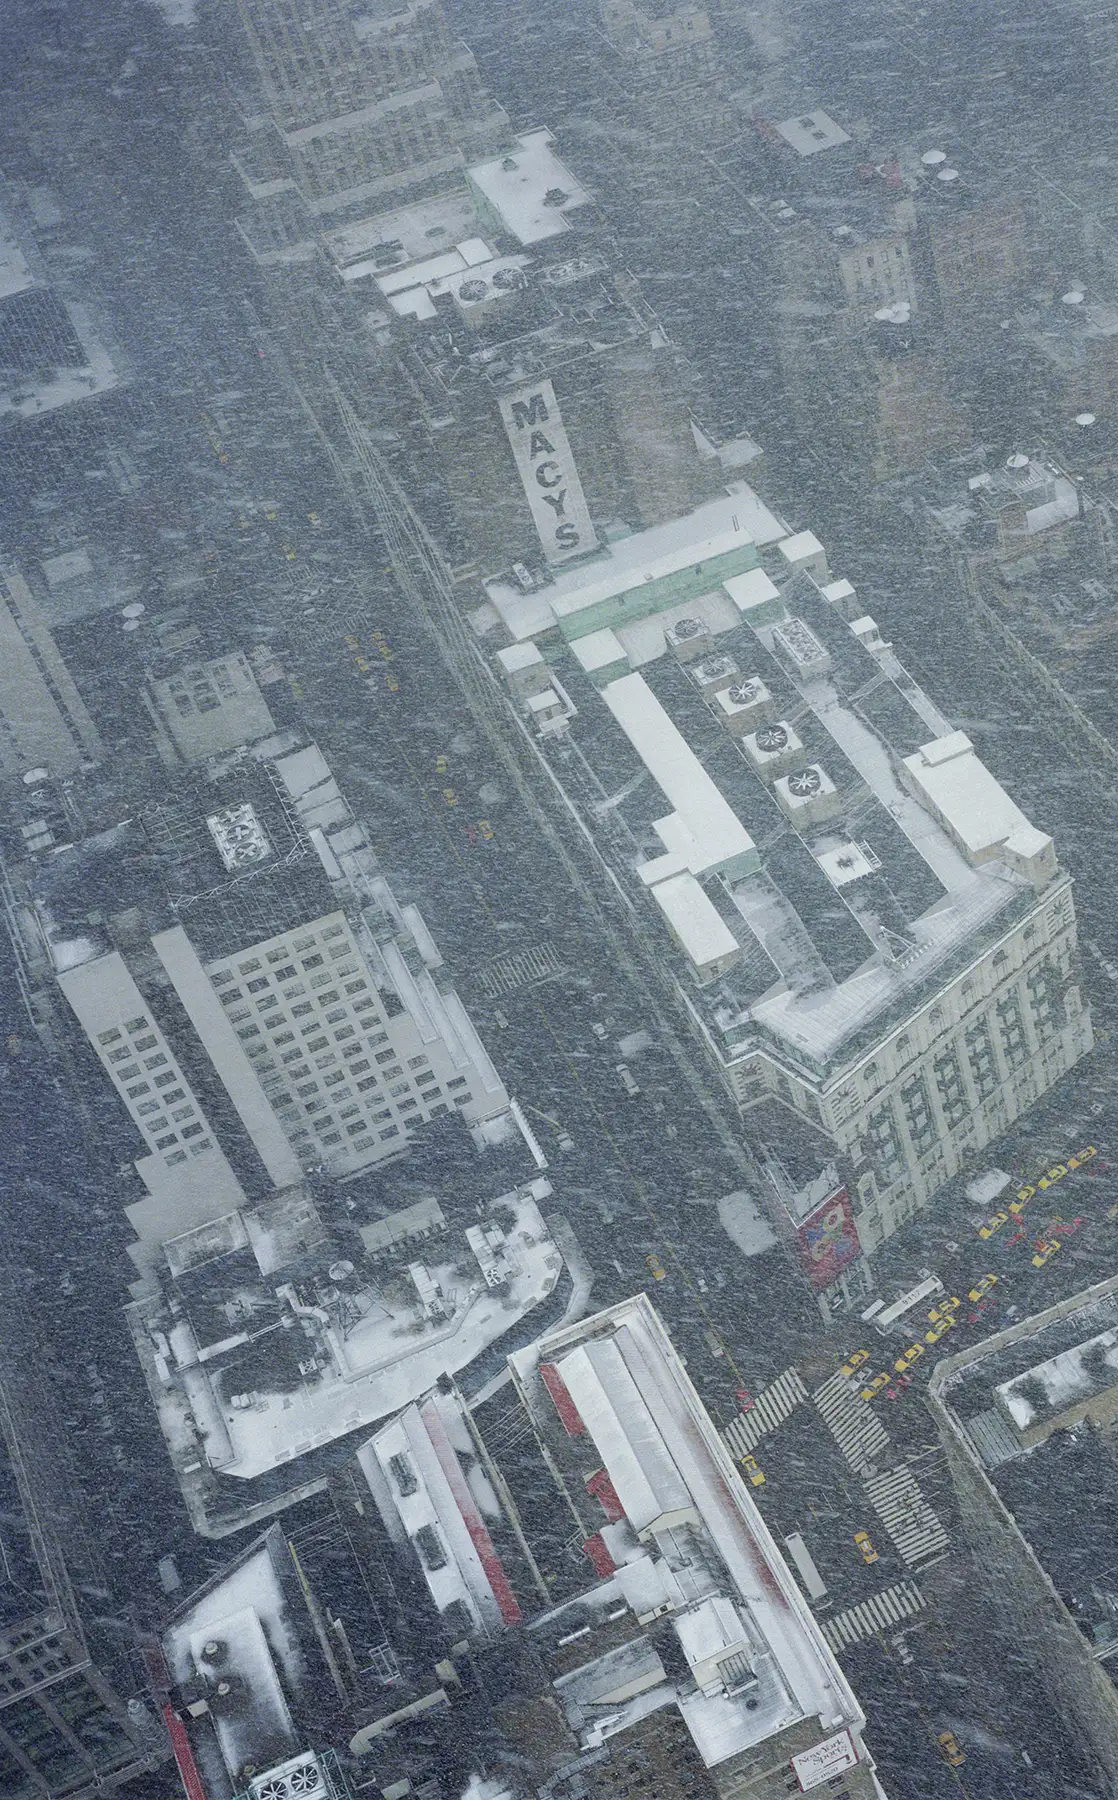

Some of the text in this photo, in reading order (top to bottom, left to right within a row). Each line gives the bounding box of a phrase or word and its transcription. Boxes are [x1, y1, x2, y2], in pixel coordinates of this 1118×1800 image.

[511, 393, 580, 550] MACYS
[798, 1737, 844, 1765] New York
[813, 1744, 848, 1765] Sports
